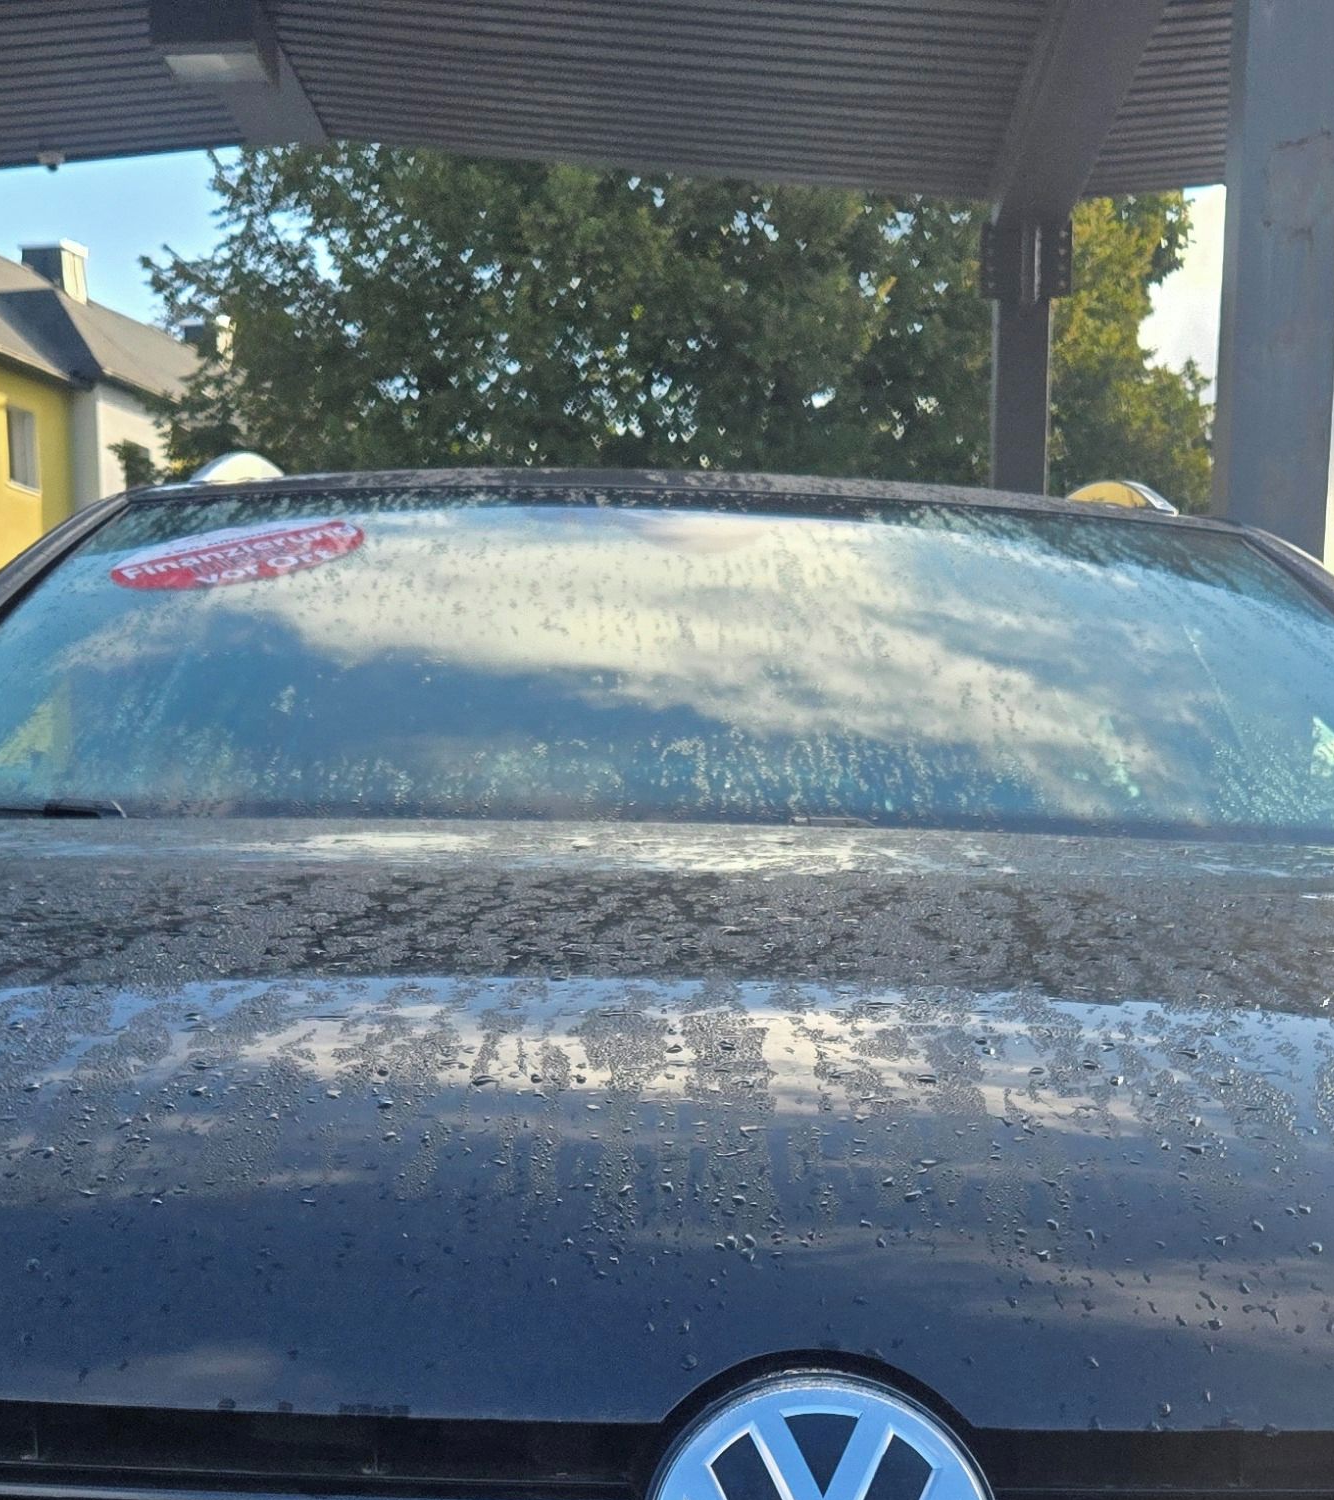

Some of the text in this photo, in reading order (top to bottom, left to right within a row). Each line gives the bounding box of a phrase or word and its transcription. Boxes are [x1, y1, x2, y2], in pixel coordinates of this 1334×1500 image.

[121, 523, 358, 580] Finanzierung
[195, 549, 332, 583] vor Ort
